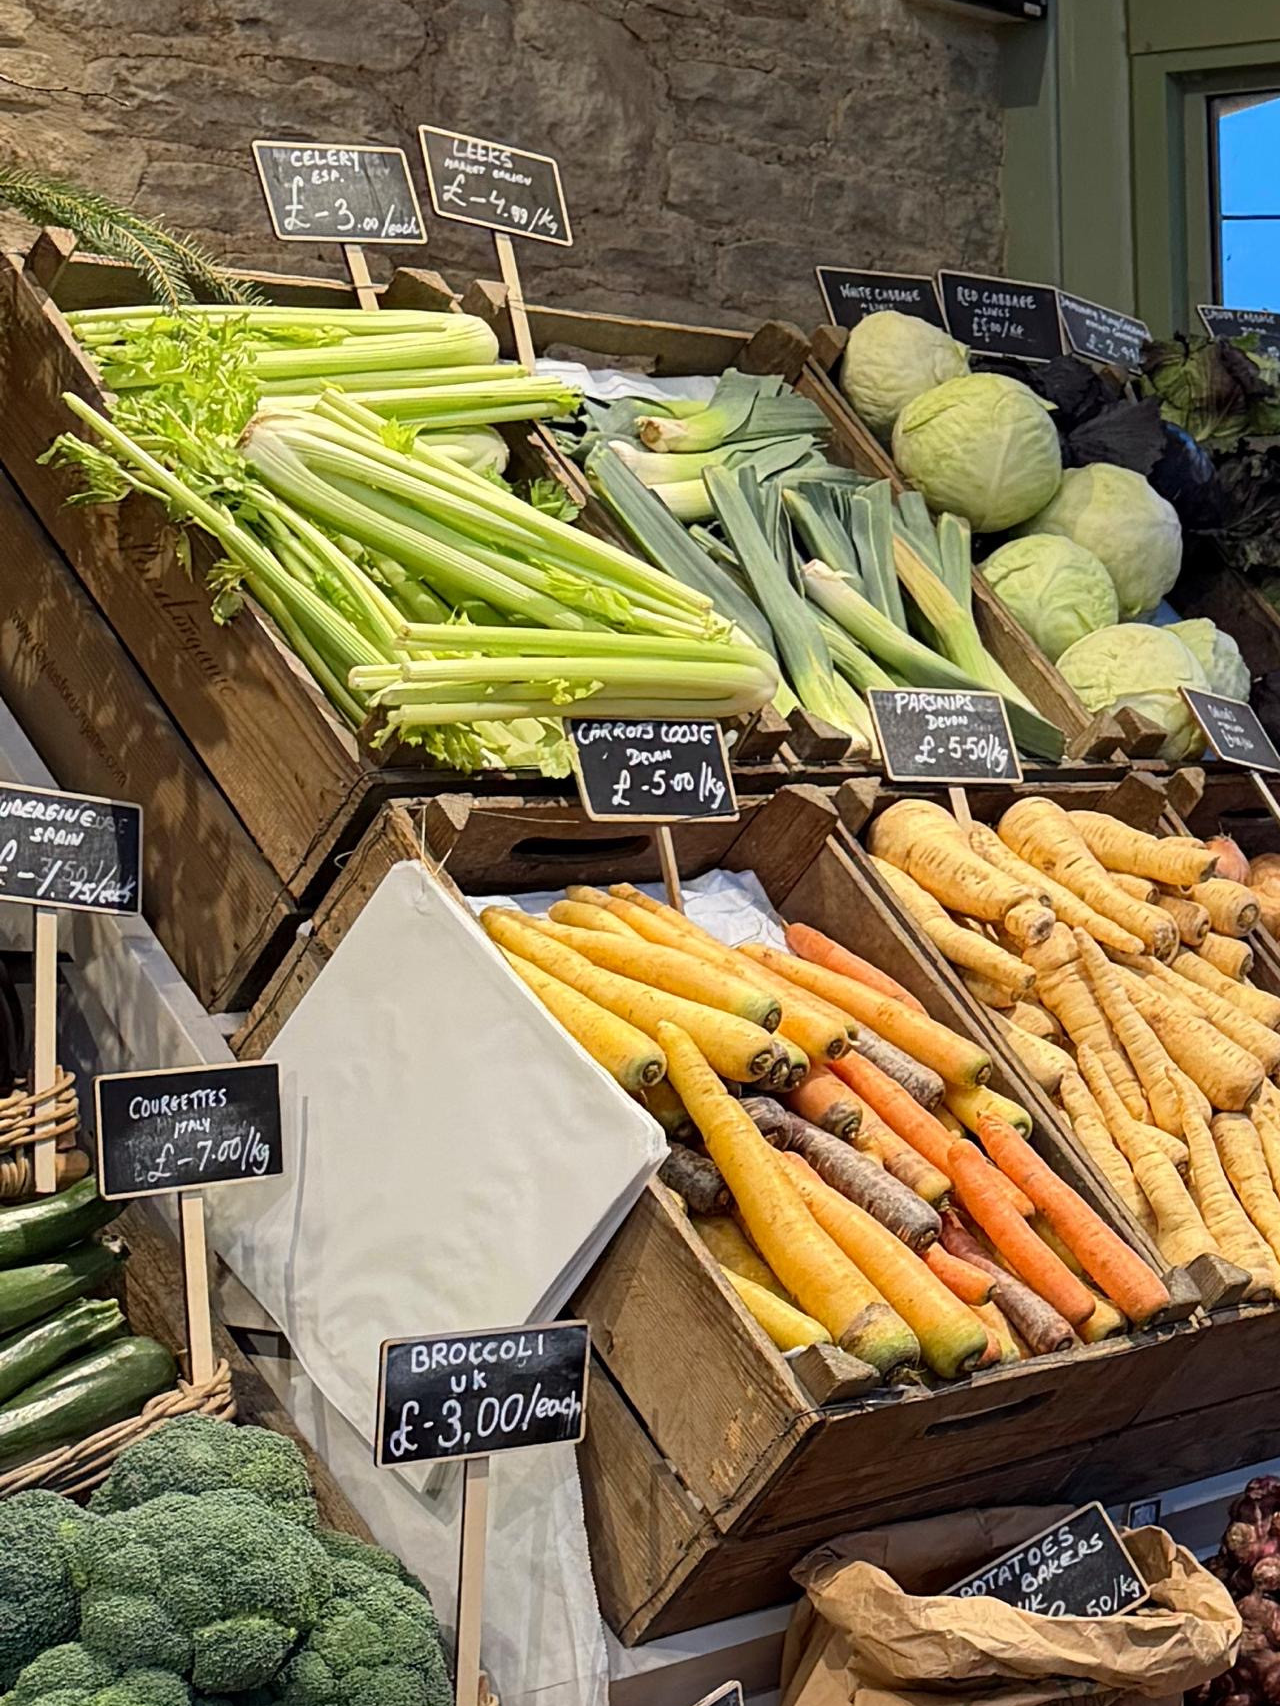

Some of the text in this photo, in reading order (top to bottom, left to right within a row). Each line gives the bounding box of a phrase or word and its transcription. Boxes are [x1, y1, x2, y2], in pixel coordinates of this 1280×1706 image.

[291, 149, 360, 172] CELERY
[453, 139, 513, 169] LEEKS
[957, 286, 979, 307] RED
[895, 693, 977, 714] PARSNIPS
[577, 723, 716, 745] CARROTS LOOSE
[0, 799, 97, 827] UBERGINE
[30, 827, 84, 846] SPAIN
[129, 1088, 227, 1120] COURGETTES
[174, 1118, 211, 1139] ITALY
[410, 1333, 545, 1373] BROCCOLI
[960, 1526, 1074, 1598] POTATOES
[1021, 1533, 1105, 1592] BAKERS
